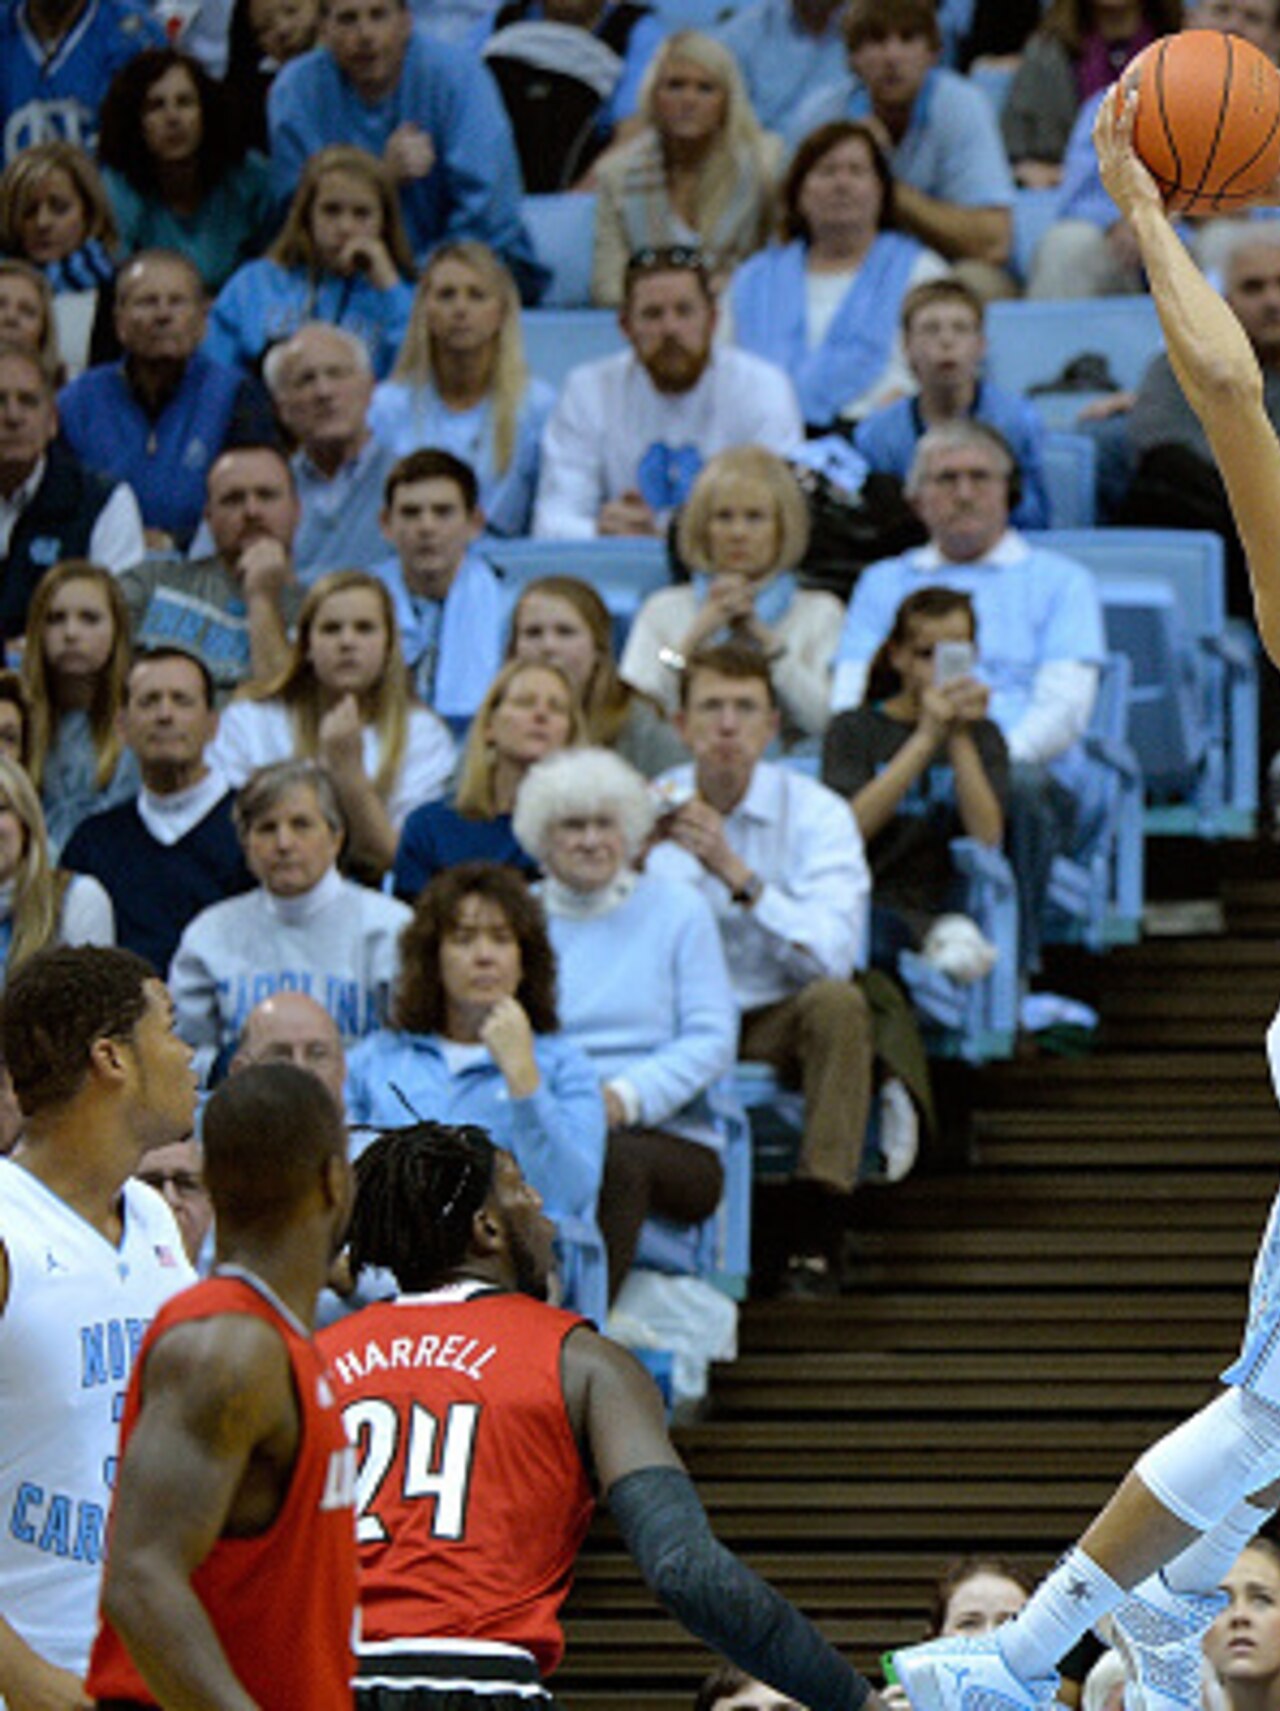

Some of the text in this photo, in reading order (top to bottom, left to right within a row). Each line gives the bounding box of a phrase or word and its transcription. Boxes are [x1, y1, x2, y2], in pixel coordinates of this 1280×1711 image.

[80, 1318, 149, 1389] NOR
[335, 1334, 497, 1386] HARRELL
[340, 1396, 482, 1545] 24
